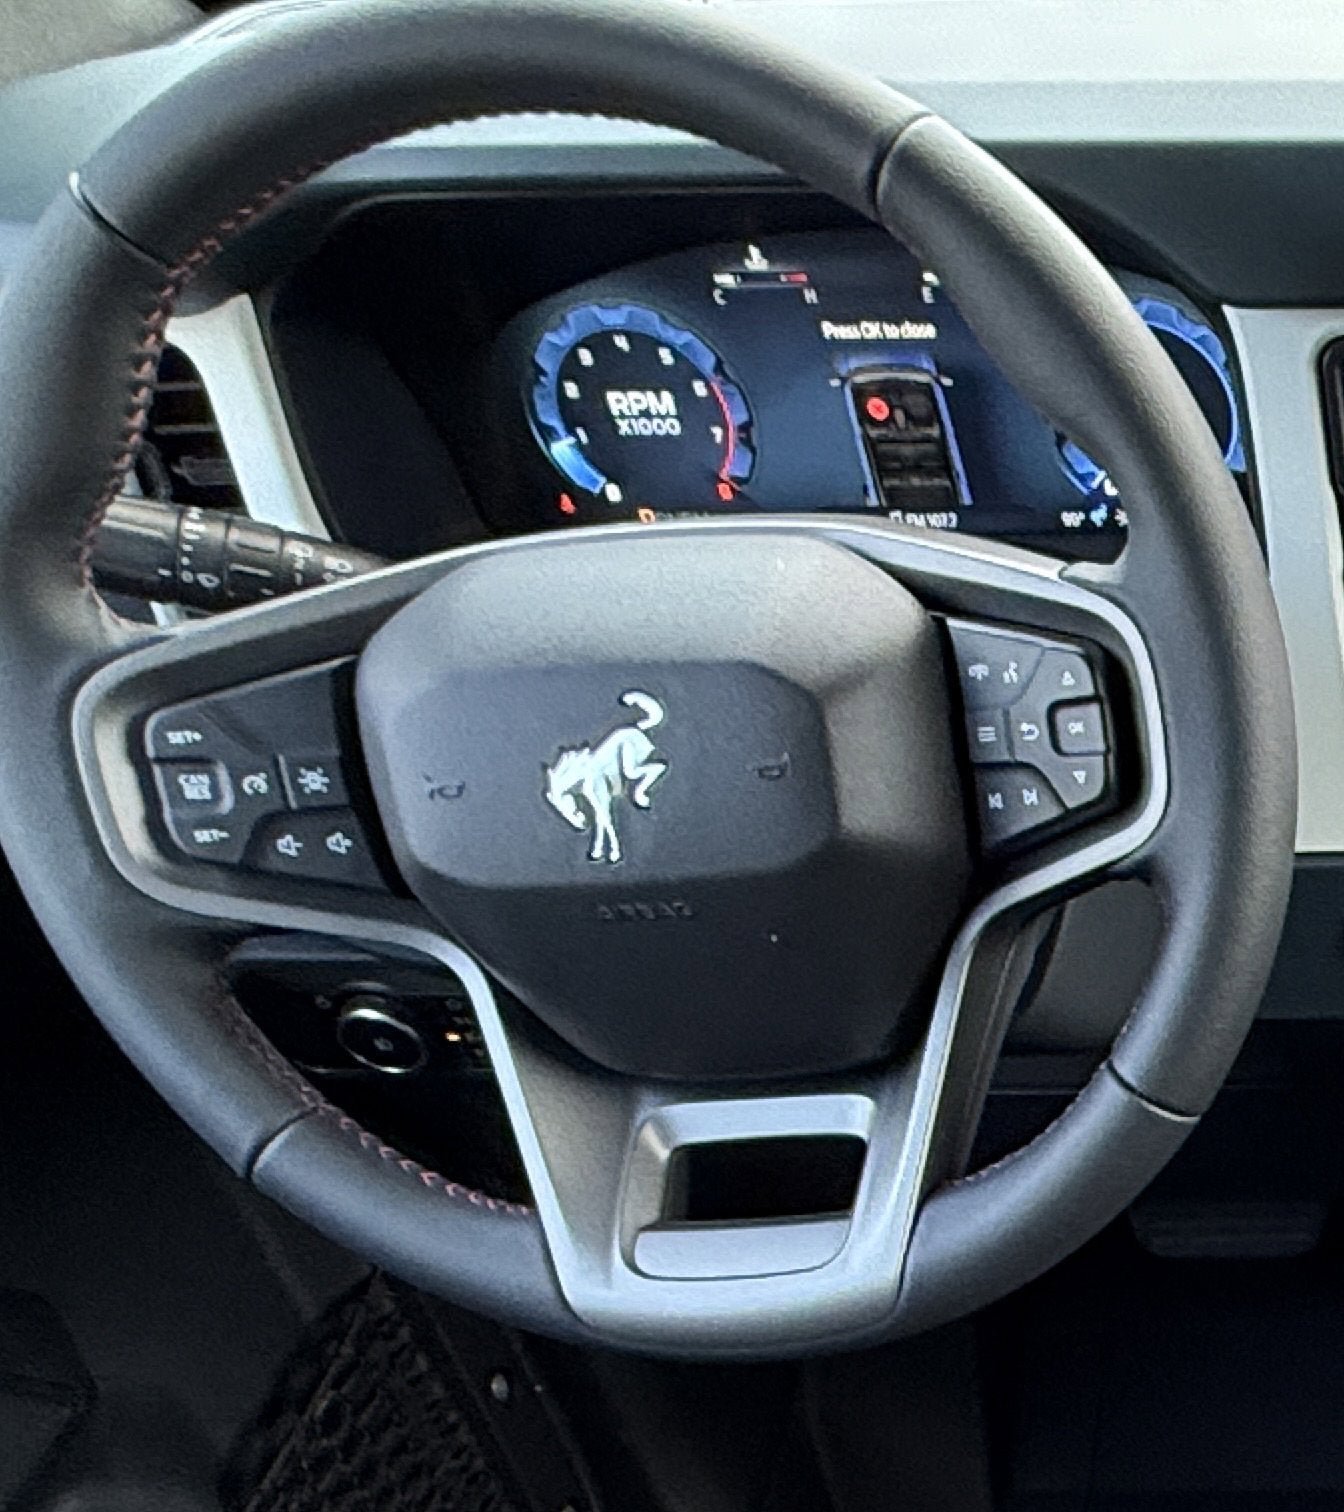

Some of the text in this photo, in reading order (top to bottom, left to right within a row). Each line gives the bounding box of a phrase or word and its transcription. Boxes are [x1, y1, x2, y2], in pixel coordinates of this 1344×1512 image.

[821, 320, 860, 340] Press
[860, 320, 883, 340] OK
[900, 319, 937, 340] close
[605, 390, 677, 416] RPM
[615, 418, 681, 435] X1000
